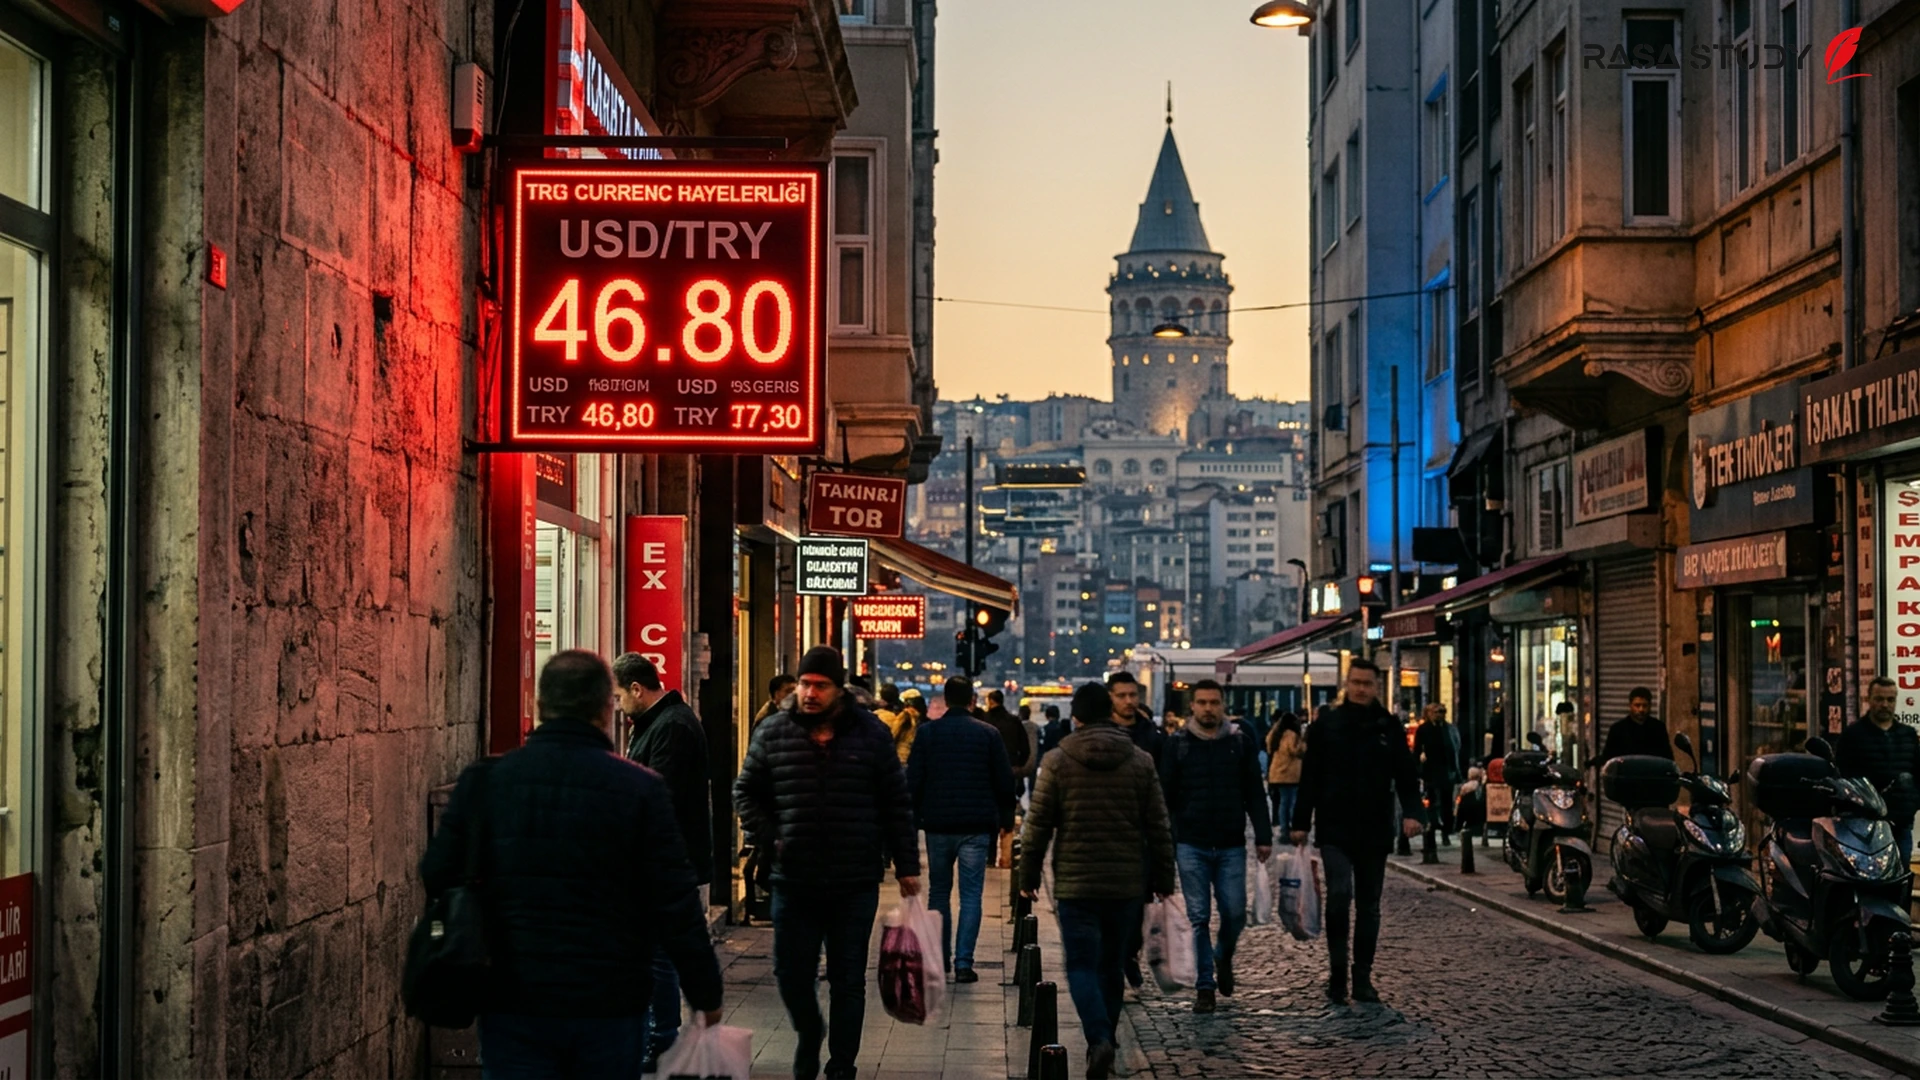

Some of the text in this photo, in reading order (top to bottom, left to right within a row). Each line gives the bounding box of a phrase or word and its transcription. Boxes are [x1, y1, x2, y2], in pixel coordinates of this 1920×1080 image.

[574, 184, 673, 201] CURRENC
[560, 219, 773, 259] USD/TRY
[534, 278, 793, 363] 46.80
[529, 377, 569, 393] USD
[677, 379, 717, 395] USD
[526, 405, 571, 423] TRY
[582, 402, 654, 432] 46,80
[674, 407, 719, 426] TRY
[829, 506, 884, 529] TOB
